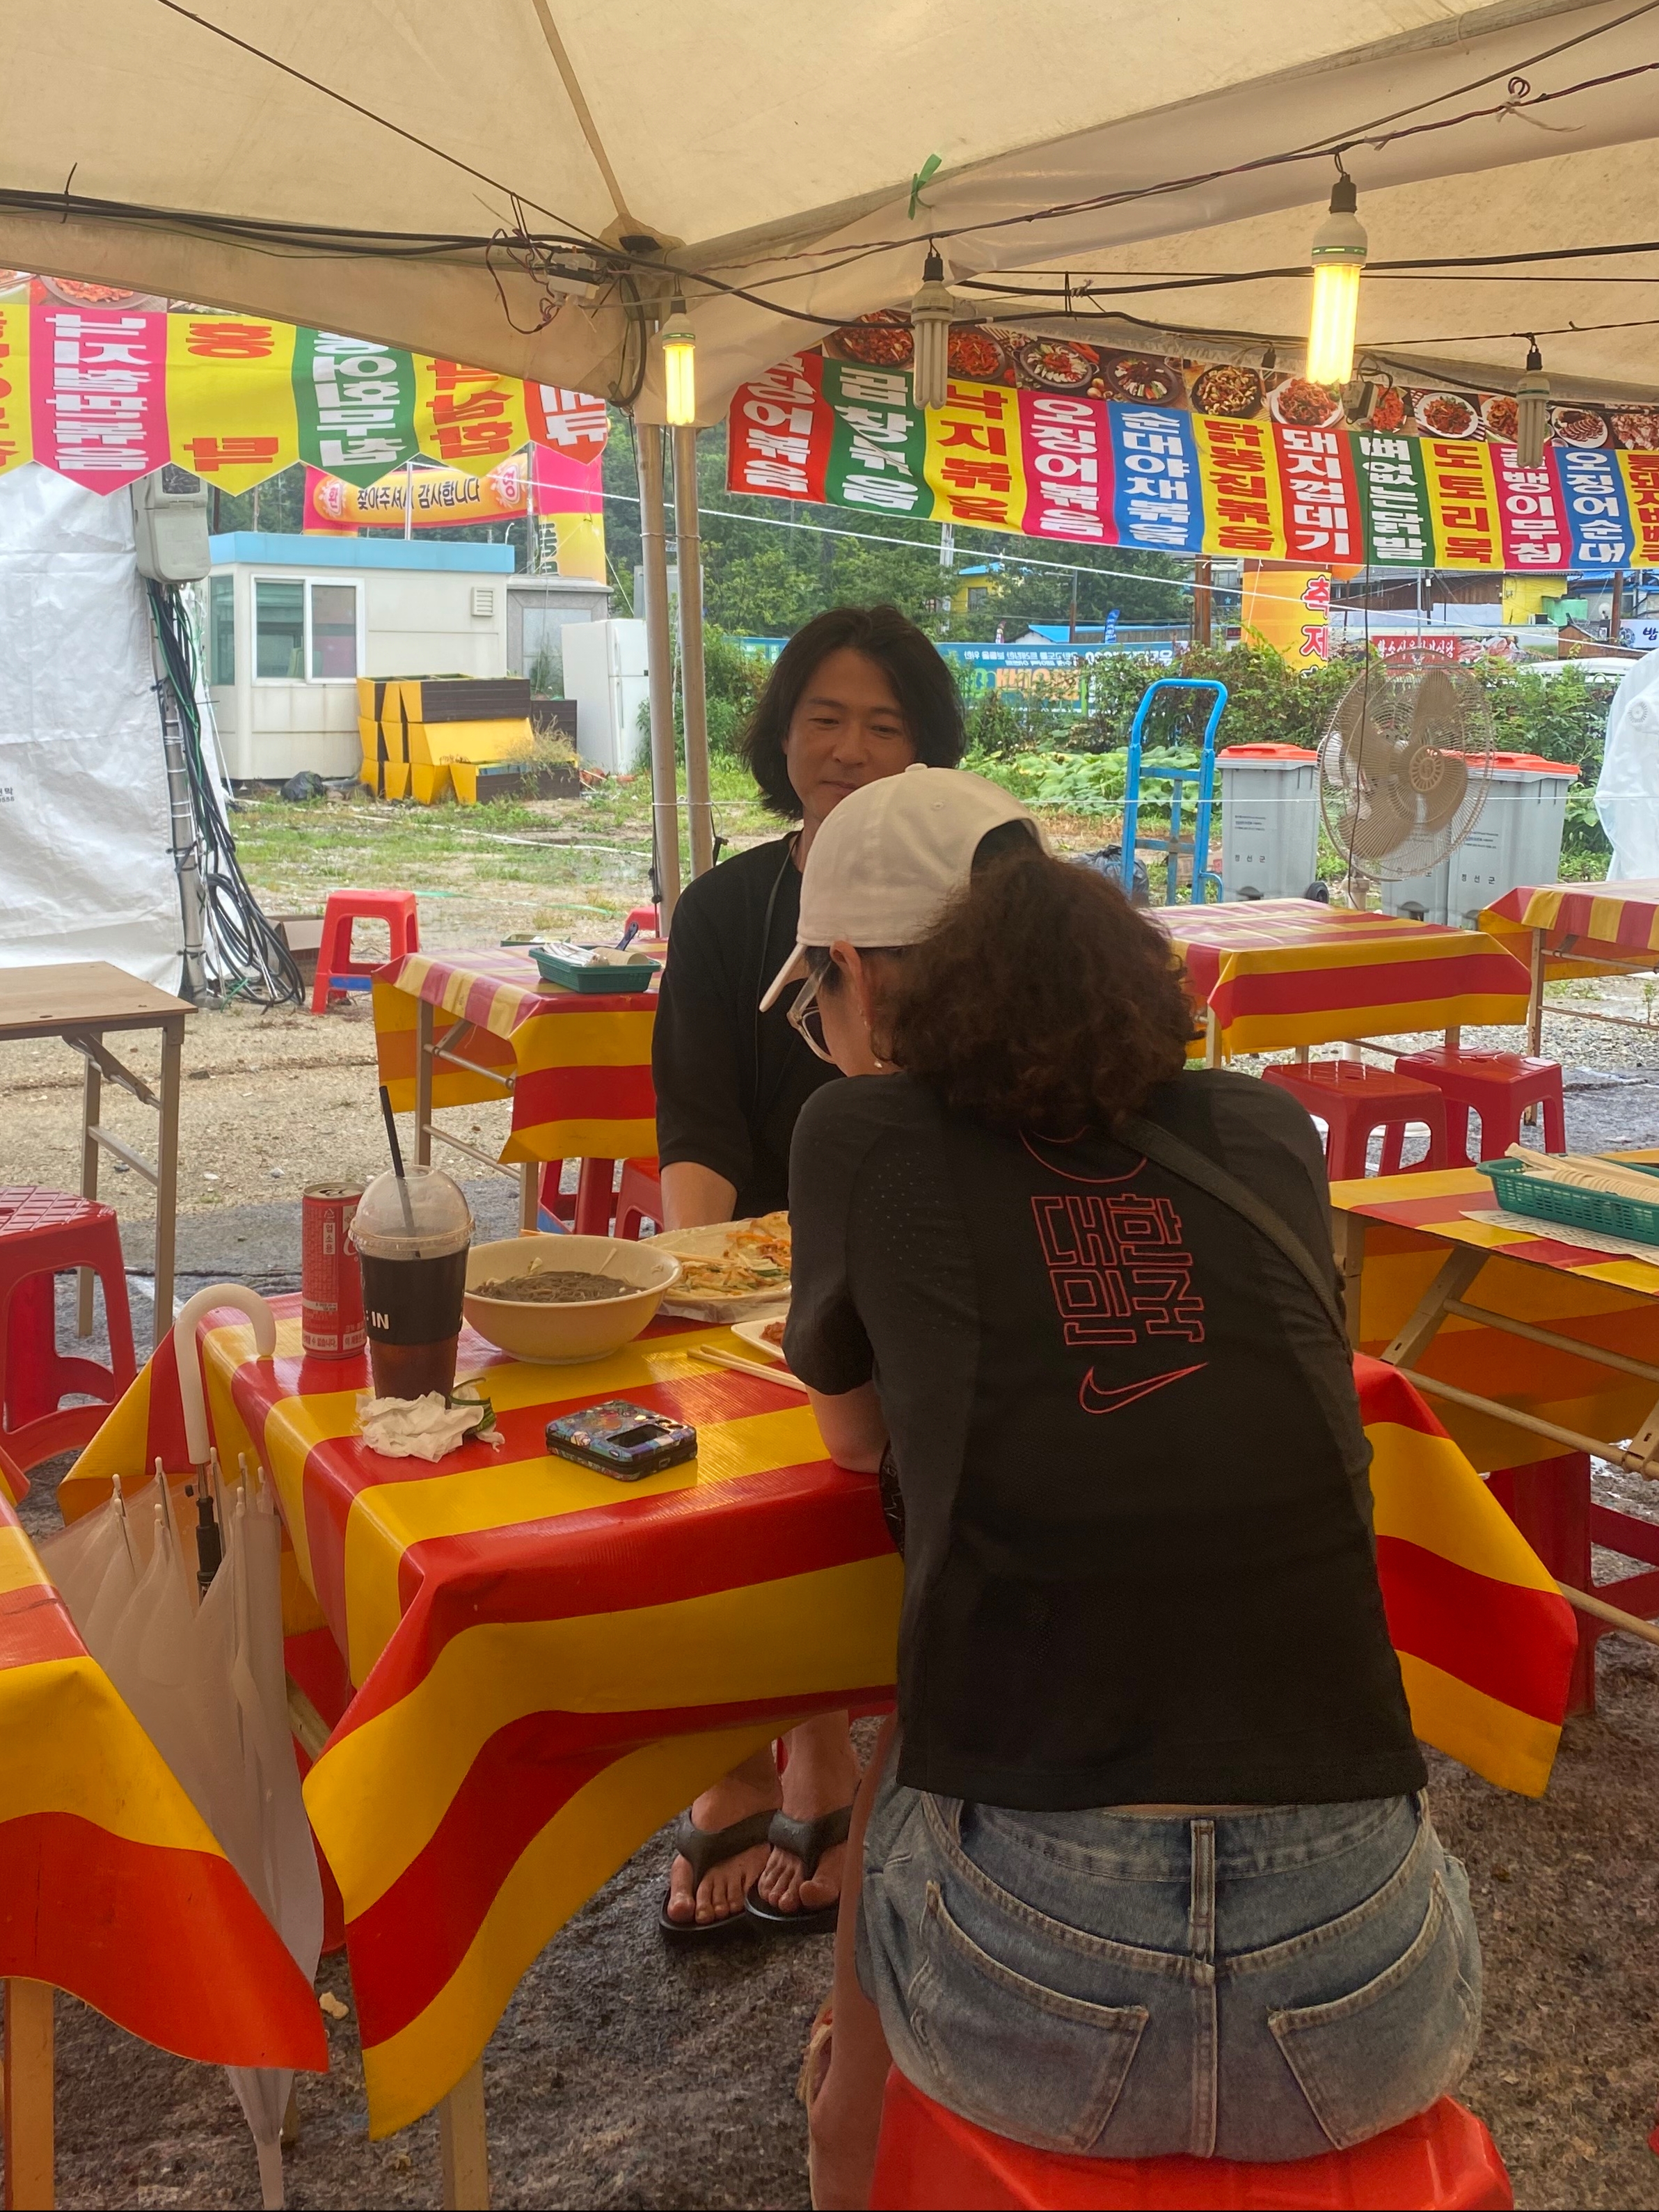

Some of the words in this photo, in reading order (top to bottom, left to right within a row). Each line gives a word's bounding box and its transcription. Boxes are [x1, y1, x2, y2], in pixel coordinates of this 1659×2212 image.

[418, 477, 480, 507] 감사합니다
[936, 384, 1013, 525] 낙지볶음
[1029, 398, 1104, 537] 오징어볶음
[1120, 411, 1191, 546] 순대야채볶음
[1203, 419, 1275, 551] 닭똥집볶음
[1281, 428, 1350, 555] 돼지껍데기
[1358, 436, 1427, 560] 뼈없는닭발
[1433, 443, 1493, 564] 도토리묵
[1565, 451, 1626, 563] 오징어순대
[325, 1224, 333, 1254] 업소용
[1031, 1193, 1193, 1266] 대한
[1049, 1269, 1205, 1345] 민국
